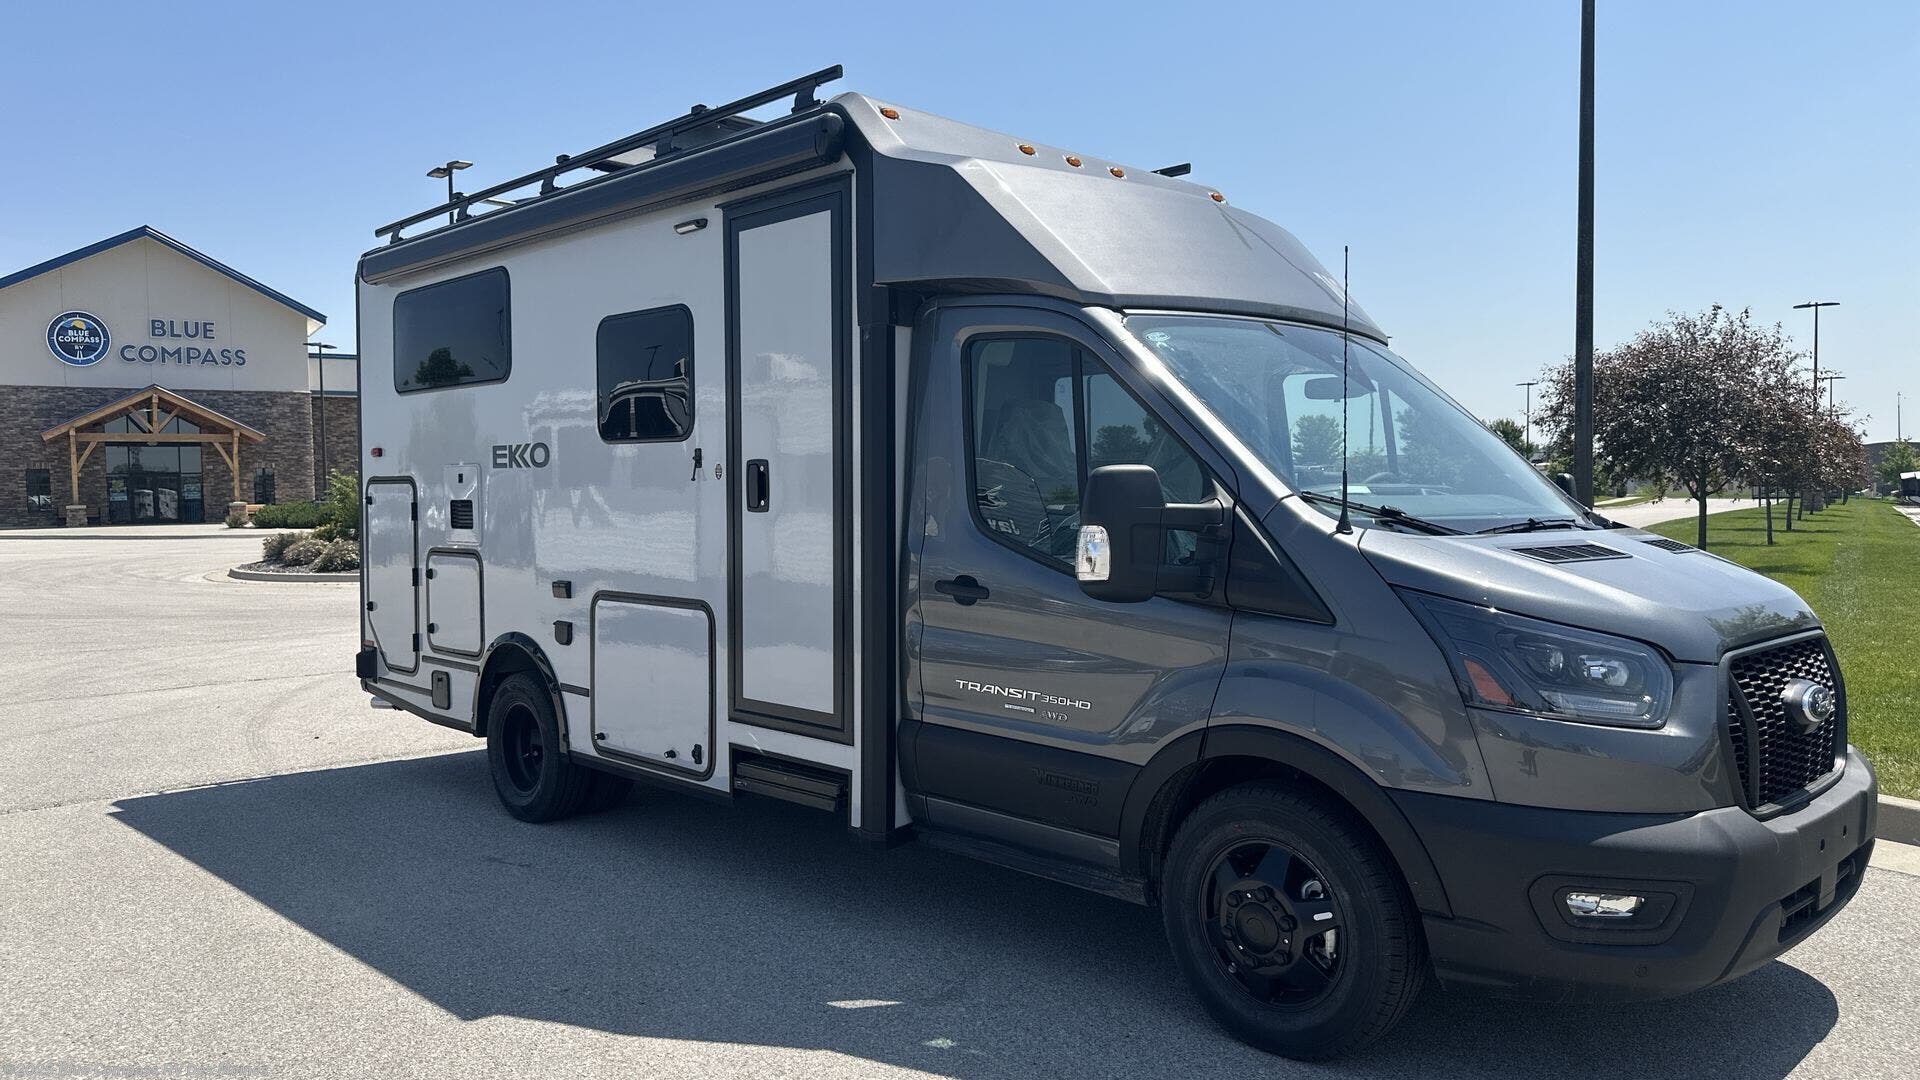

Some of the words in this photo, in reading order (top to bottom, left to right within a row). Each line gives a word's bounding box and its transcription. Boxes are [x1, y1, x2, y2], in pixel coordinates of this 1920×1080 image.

[151, 319, 215, 339] BLUE
[120, 344, 246, 366] COMPASS
[493, 442, 550, 469] EKKO
